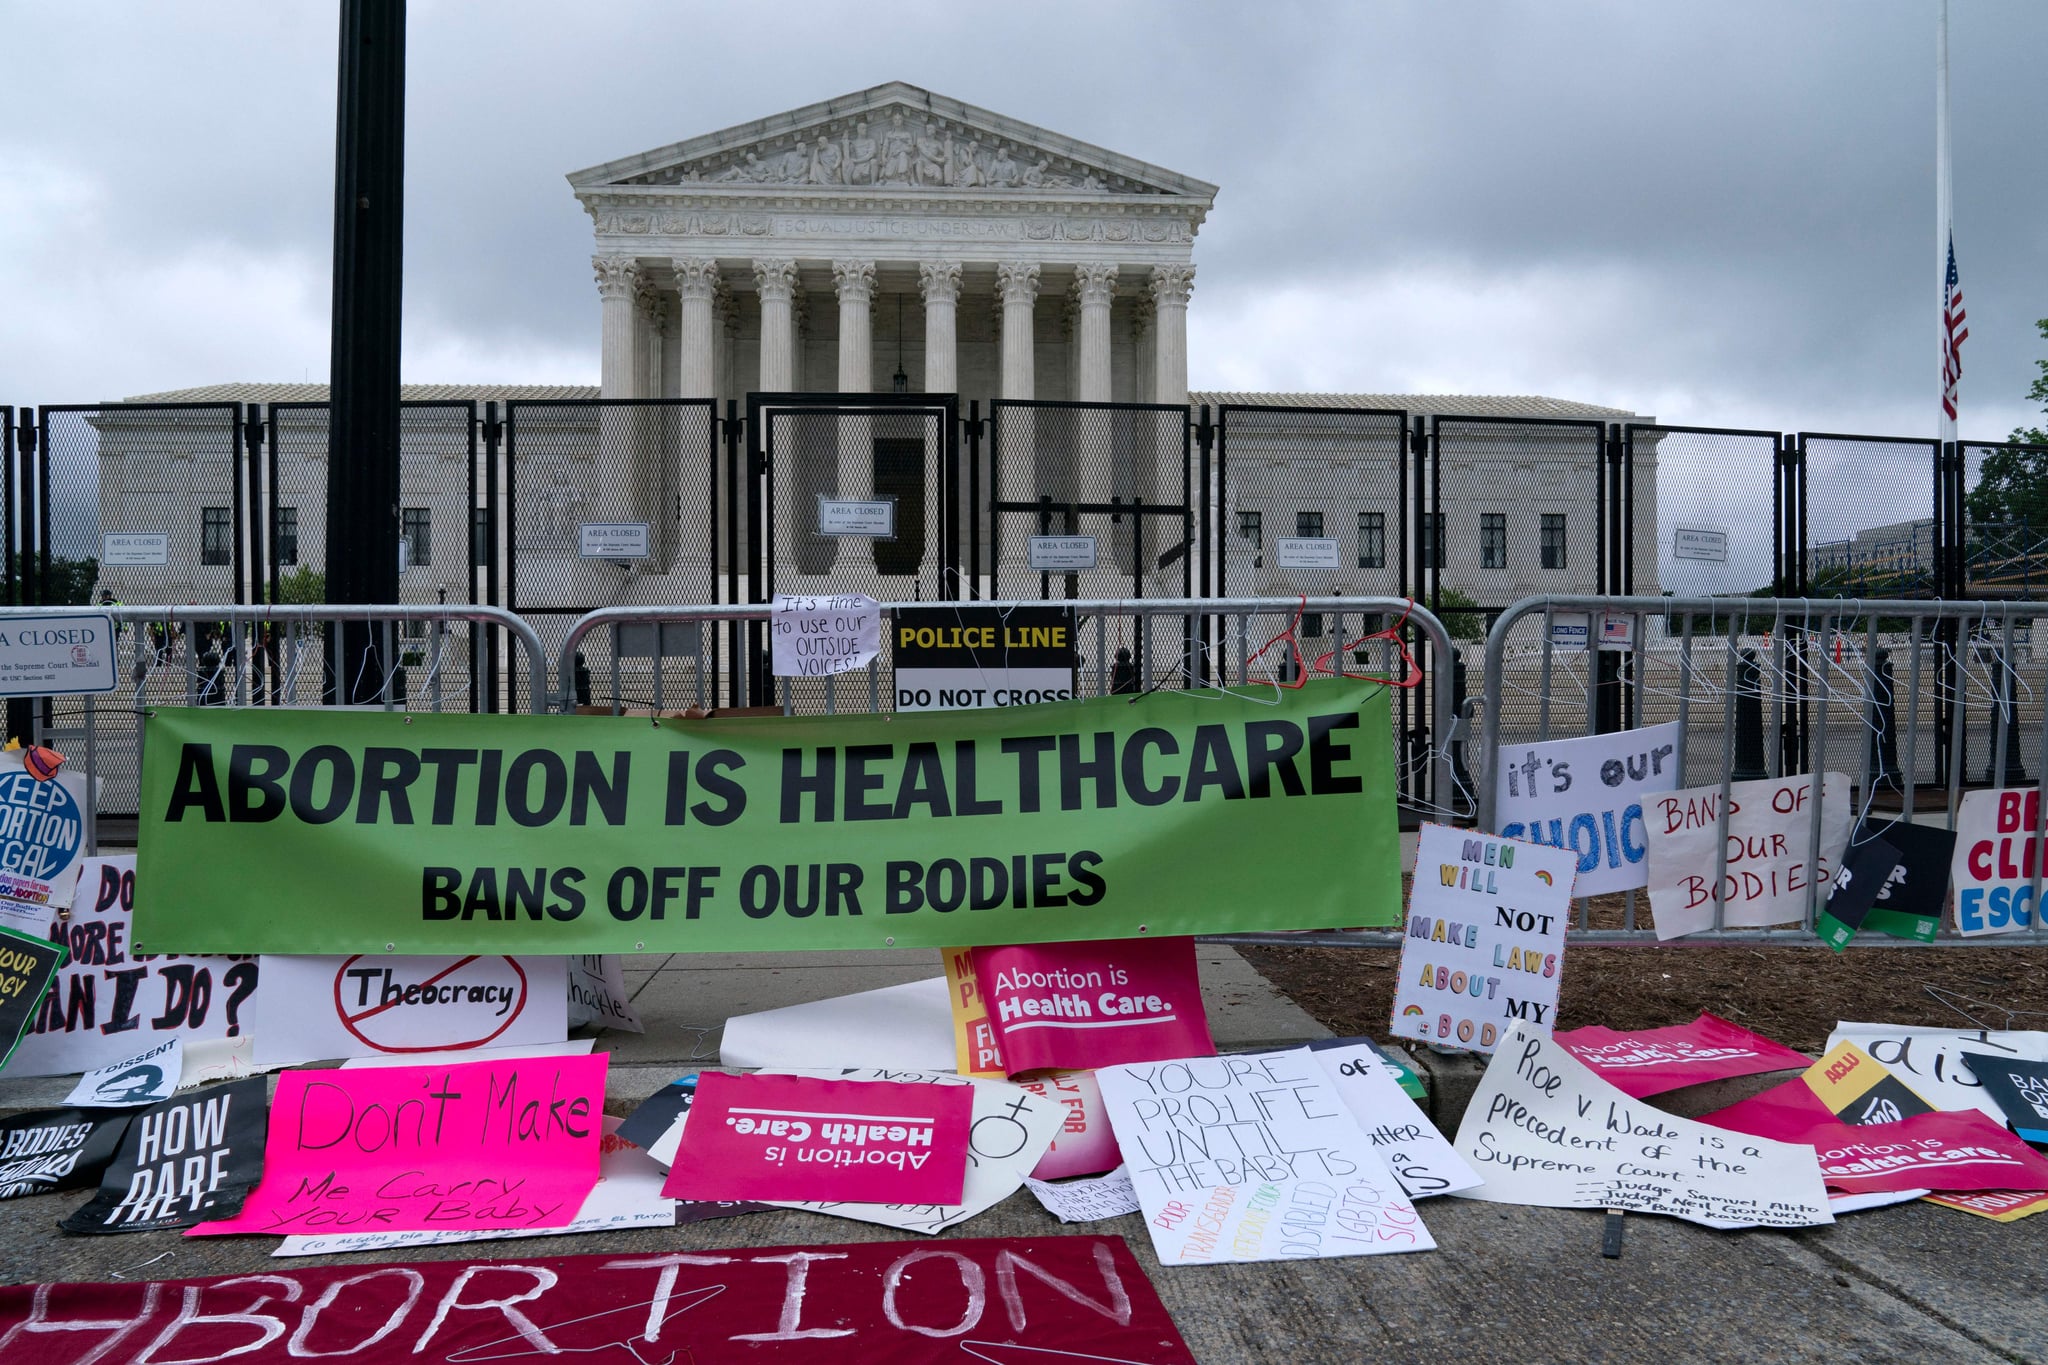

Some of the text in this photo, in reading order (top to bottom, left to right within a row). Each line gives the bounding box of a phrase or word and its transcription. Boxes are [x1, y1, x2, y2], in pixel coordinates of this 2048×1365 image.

[785, 219, 1010, 236] EQUAL JUSTICE UNDER LAW
[830, 507, 884, 515] AREA CLOSED
[111, 538, 162, 546] AREA CLOSED
[588, 529, 640, 537] AREA CLOSED
[1037, 541, 1088, 550] AREA CLOSED
[1306, 543, 1332, 551] CLOSED
[780, 595, 861, 613] It's time
[19, 628, 95, 646] CLOSED
[772, 614, 867, 635] to use our
[900, 626, 1067, 648] POLICE LINE
[796, 636, 861, 657] OUTSIDE
[14, 662, 45, 671] Supreme
[47, 661, 68, 669] Court
[899, 688, 1071, 707] DO NOT CROSS
[164, 711, 1364, 828] ABORTION IS HEALTHCARE
[1507, 743, 1673, 798] it's our
[1461, 839, 1516, 869] MEN
[421, 850, 1107, 922] BANS OFF OUR BODIES
[1410, 915, 1480, 949] MAKE
[1494, 905, 1555, 936] NOT
[1493, 943, 1557, 978] LAWS
[346, 967, 514, 1017] Theocracy
[994, 967, 1102, 997] Abortion
[1108, 964, 1129, 987] is
[1419, 963, 1501, 1000] ABOUT
[100, 966, 148, 1036] I
[998, 993, 1092, 1023] Health
[1098, 992, 1173, 1016] Care.
[1504, 997, 1550, 1024] MY
[105, 1038, 178, 1073] DISSENT
[1823, 1052, 1861, 1085] ACLU
[1124, 1056, 1309, 1095] YOU'RE
[297, 1069, 591, 1154] Don't Make
[1132, 1084, 1339, 1132] PRO-LIFE
[3, 1121, 94, 1160] BODIES
[136, 1093, 232, 1166] HOW
[725, 1117, 934, 1147] Health Care.
[1137, 1121, 1328, 1168] UNTIL
[1486, 1092, 1748, 1177] precedent of the
[1606, 1100, 1679, 1141] Wade
[1699, 1134, 1725, 1151] is
[1741, 1145, 1765, 1160] a
[1911, 1138, 1943, 1149] is
[764, 1145, 931, 1171] Abortion is
[1473, 1132, 1597, 1175] Supreme
[1917, 1145, 2013, 1162] Care.
[118, 1148, 231, 1206] DARE
[288, 1170, 526, 1205] Me Carry
[1138, 1149, 1358, 1195] THE BABY IS
[260, 1199, 564, 1231] YOUR Baby
[1153, 1200, 1195, 1231] POOR
[1651, 1202, 1691, 1215] Brett
[1671, 1196, 1808, 1220] Neil Gorsuch
[1687, 1188, 1820, 1214] Samuel Alito
[1279, 1181, 1338, 1257] DISABLED
[1377, 1201, 1417, 1244] SICK
